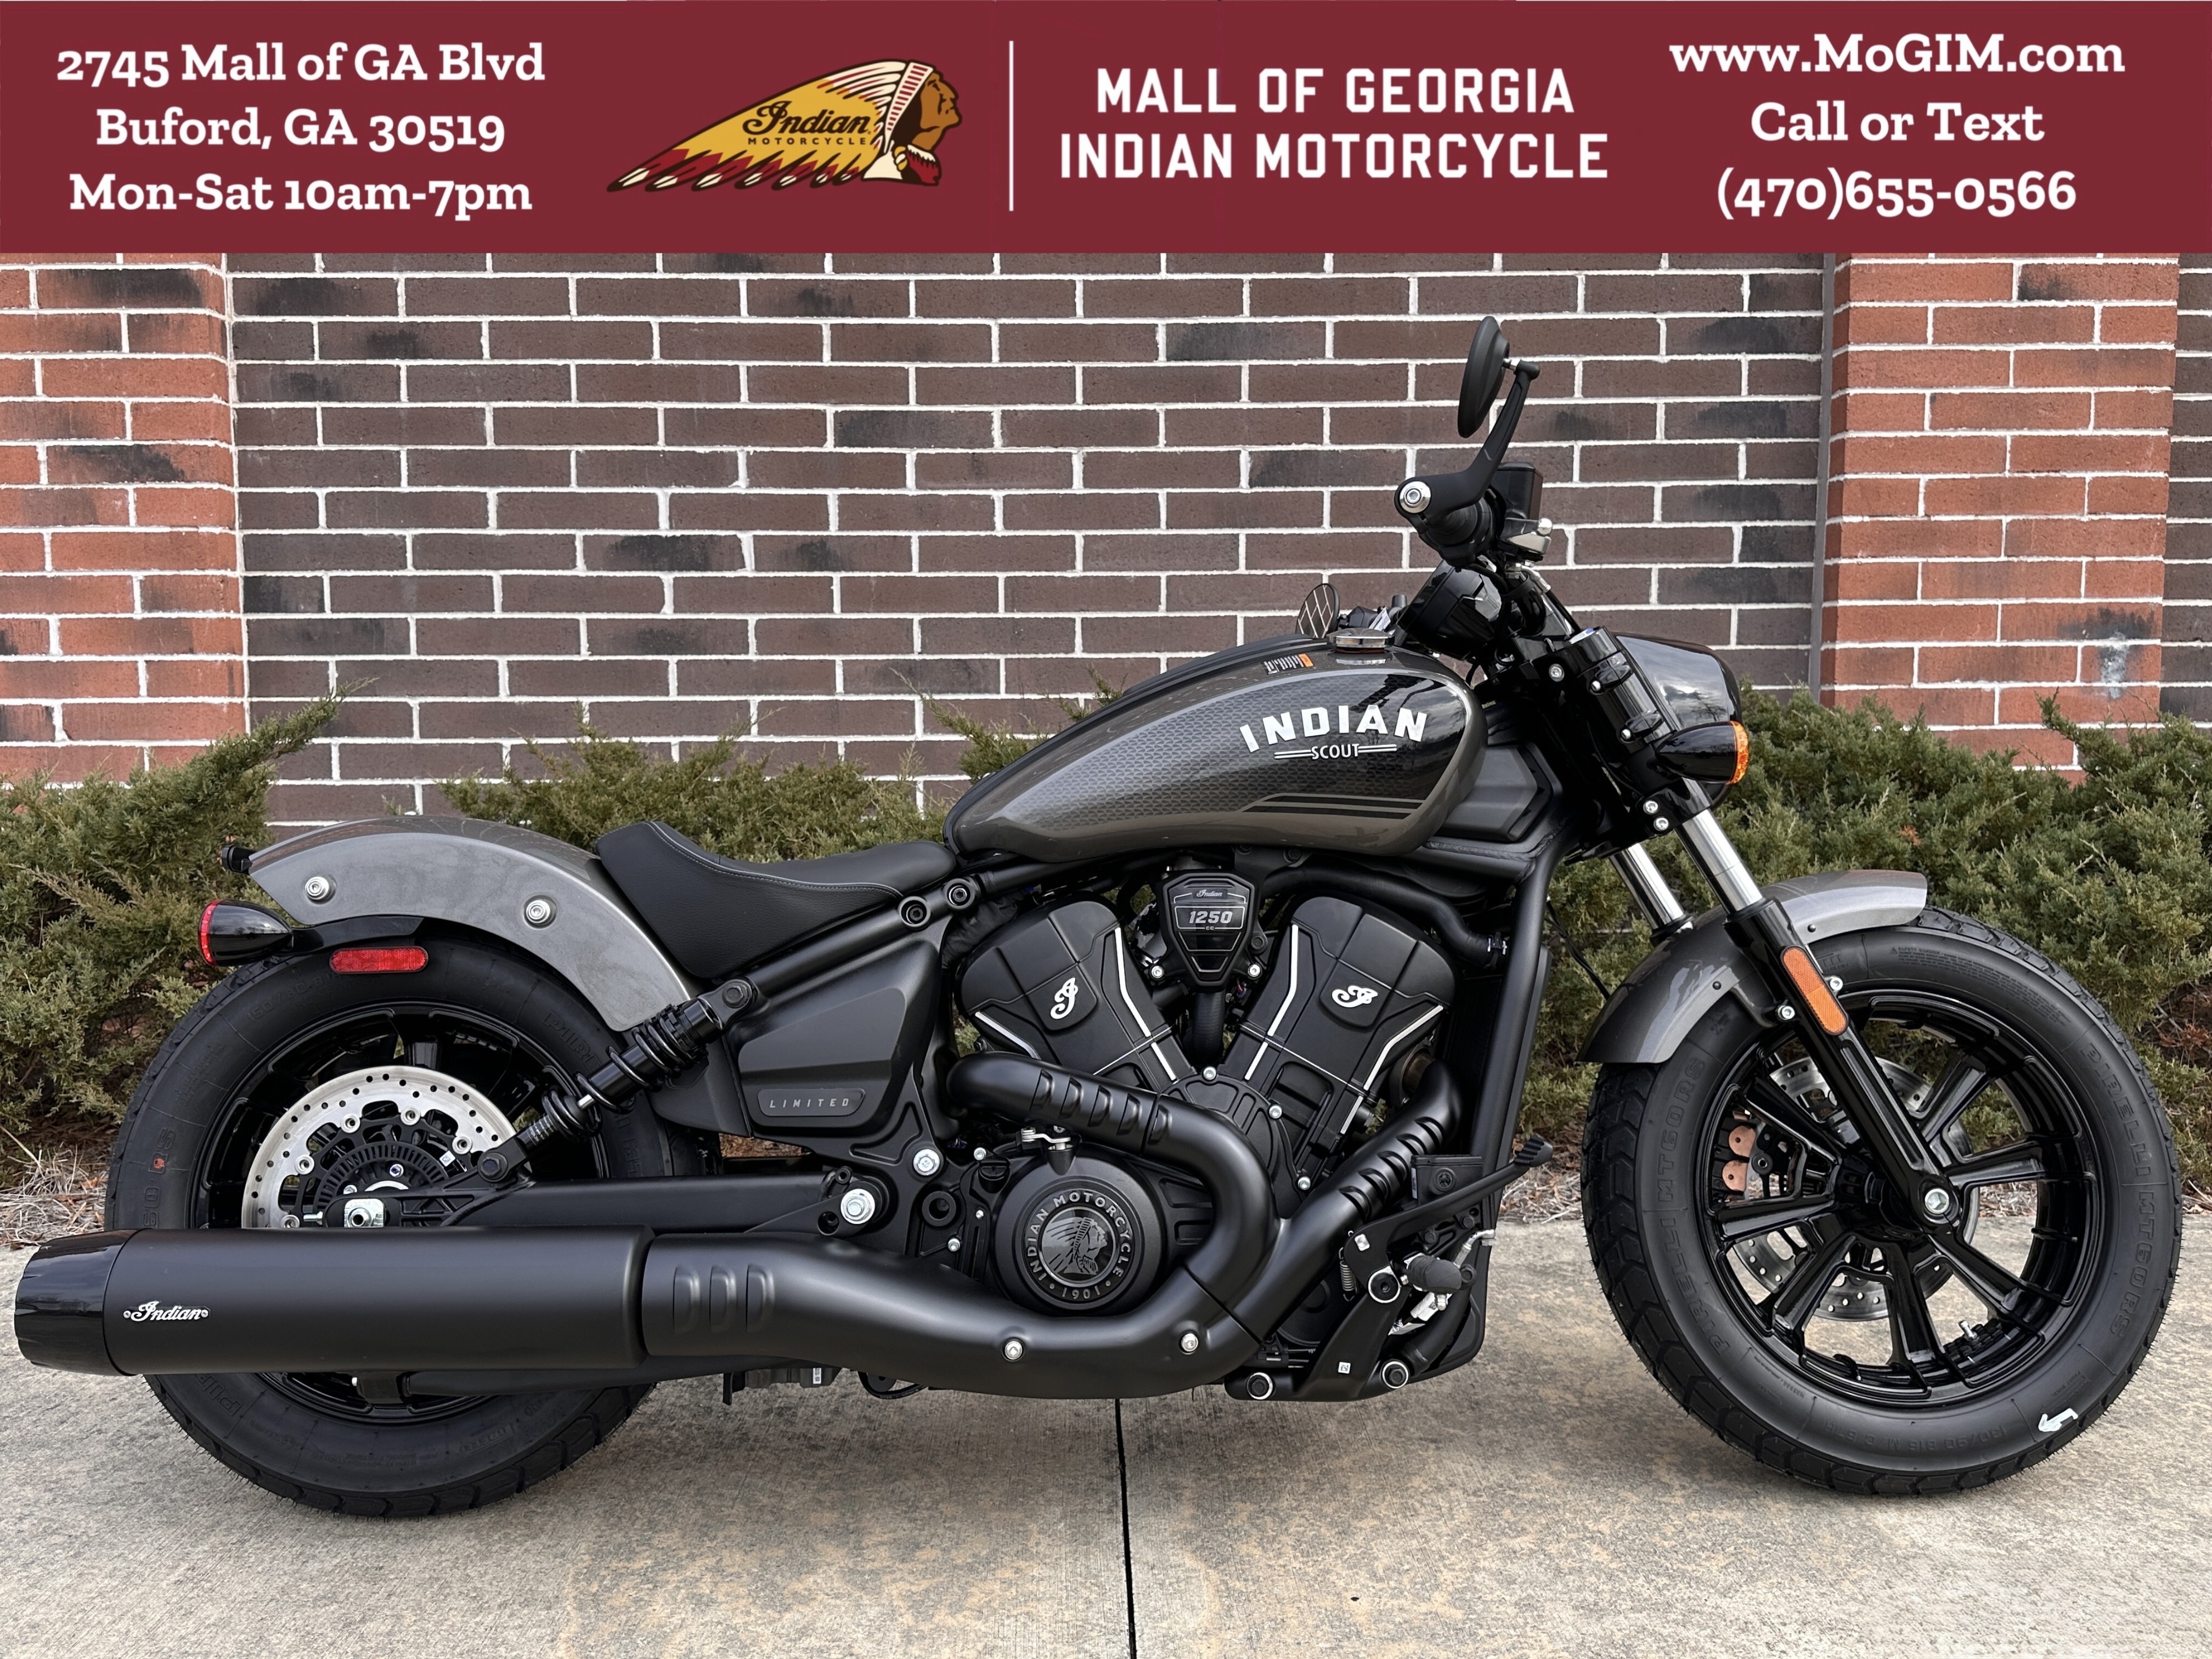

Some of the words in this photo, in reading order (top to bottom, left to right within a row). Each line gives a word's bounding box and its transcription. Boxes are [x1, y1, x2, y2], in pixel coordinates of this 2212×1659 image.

[1240, 704, 1427, 753] INDIAN
[1311, 743, 1359, 760] SCOUT
[1196, 889, 1223, 898] Indian
[1189, 911, 1233, 924] 1250
[770, 1098, 849, 1108] LIMITED
[2079, 1042, 2152, 1178] PIRELLI
[1027, 1208, 1049, 1281] INDIAN
[1053, 1192, 1132, 1277] MOTORCYCLE
[1062, 1285, 1101, 1300] 1901
[1660, 1217, 1729, 1356] PIRELLI
[130, 1300, 202, 1322] Indian
